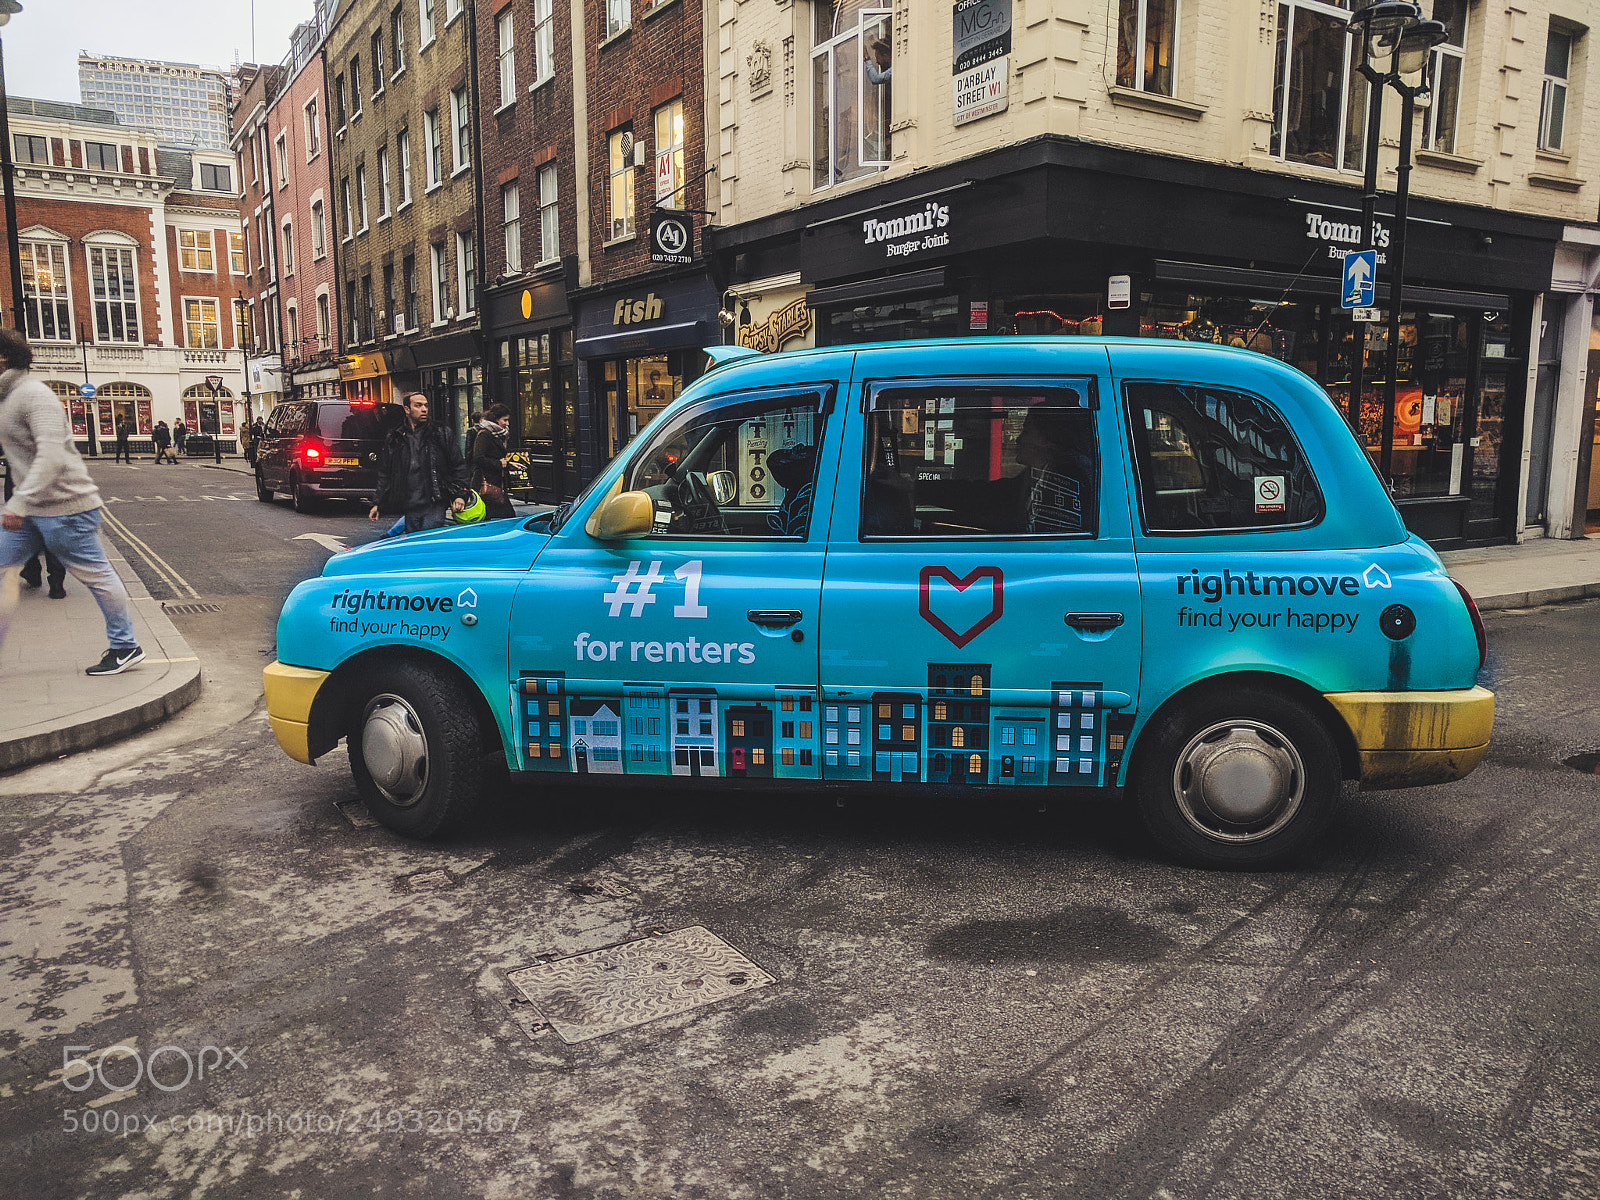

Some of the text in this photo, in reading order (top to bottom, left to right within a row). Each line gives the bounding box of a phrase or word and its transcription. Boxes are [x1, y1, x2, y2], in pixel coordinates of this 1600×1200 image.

[959, 60, 971, 71] 020
[957, 66, 997, 93] D'ARBLAY
[957, 80, 1001, 108] STREET W1
[956, 113, 965, 122] CITY
[971, 102, 999, 117] WESTMINSTER
[659, 154, 670, 177] A1
[661, 224, 681, 247] A1
[863, 202, 950, 245] Tommi's
[886, 231, 950, 257] Burger Joint
[652, 253, 692, 264] 020 7437 2710
[613, 292, 663, 326] fish
[767, 301, 807, 353] STABLES
[1541, 320, 1548, 338] 7
[918, 472, 942, 481] SPECIAL
[603, 560, 708, 618] #1
[1176, 568, 1360, 603] rightmove
[331, 589, 453, 615] rightmove
[330, 616, 452, 641] find your happy
[1178, 606, 1360, 634] find your happy
[574, 632, 756, 664] for renters
